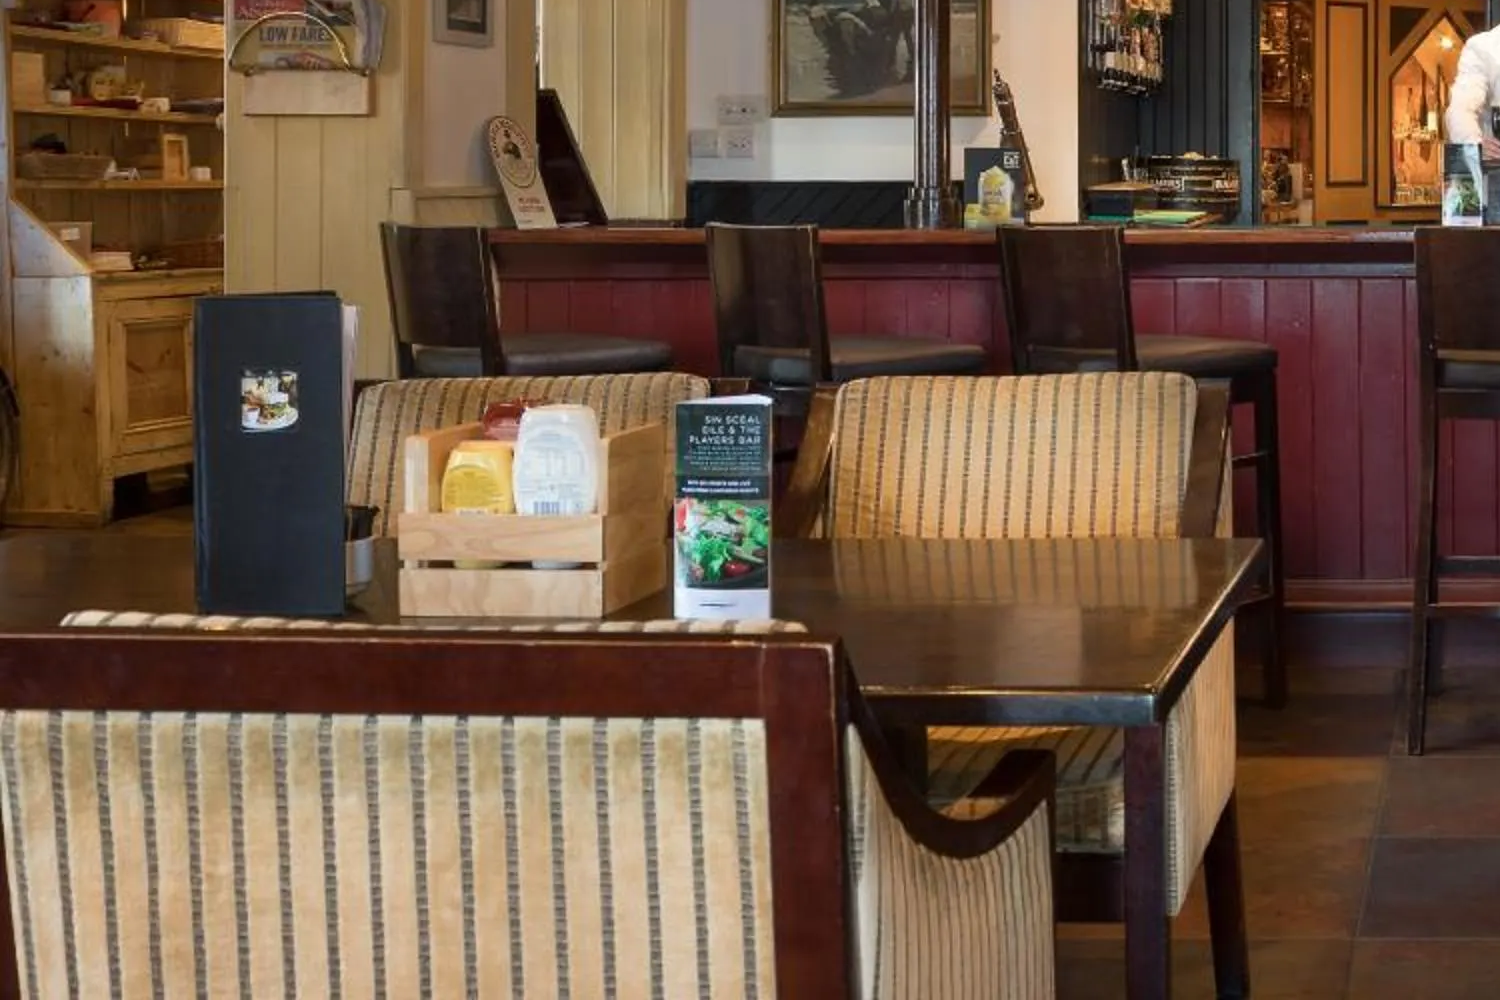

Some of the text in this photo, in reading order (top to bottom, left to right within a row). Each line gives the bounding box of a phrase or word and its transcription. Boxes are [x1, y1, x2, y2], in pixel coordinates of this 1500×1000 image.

[258, 27, 288, 42] LOW
[689, 434, 761, 445] PLAYERS BAR
